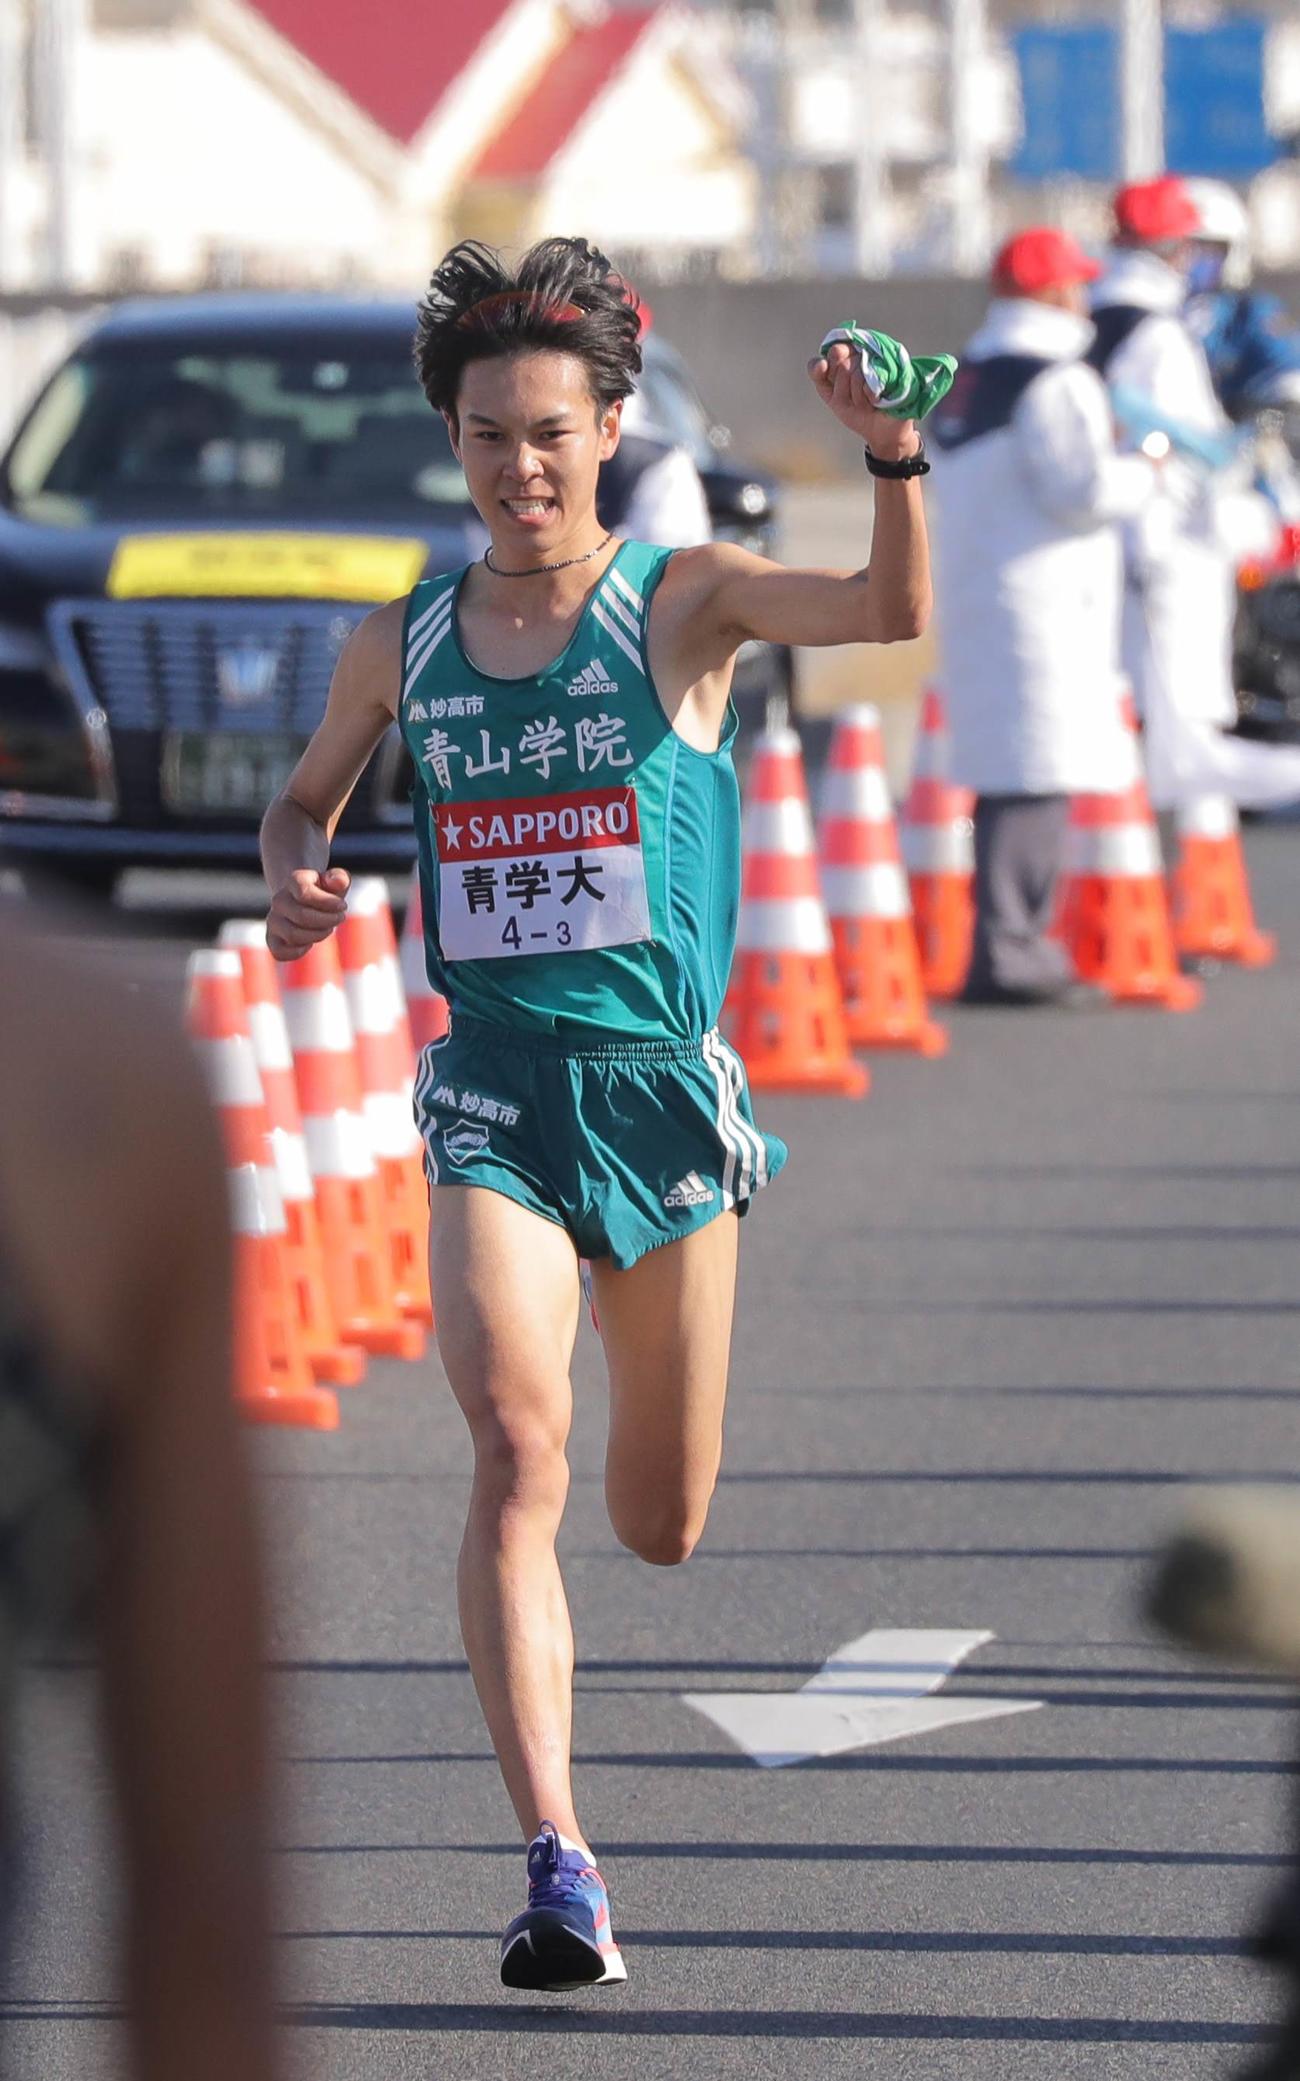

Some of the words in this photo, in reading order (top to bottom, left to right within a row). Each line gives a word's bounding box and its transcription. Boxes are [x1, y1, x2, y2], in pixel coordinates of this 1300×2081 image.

[568, 681, 619, 696] adidas
[430, 696, 485, 719] 妙高市
[422, 714, 634, 789] 青山学院
[469, 802, 630, 849] SAPPORO
[461, 856, 606, 914] 青学大
[459, 1091, 521, 1127] 妙高市
[663, 1191, 714, 1208] adidas
